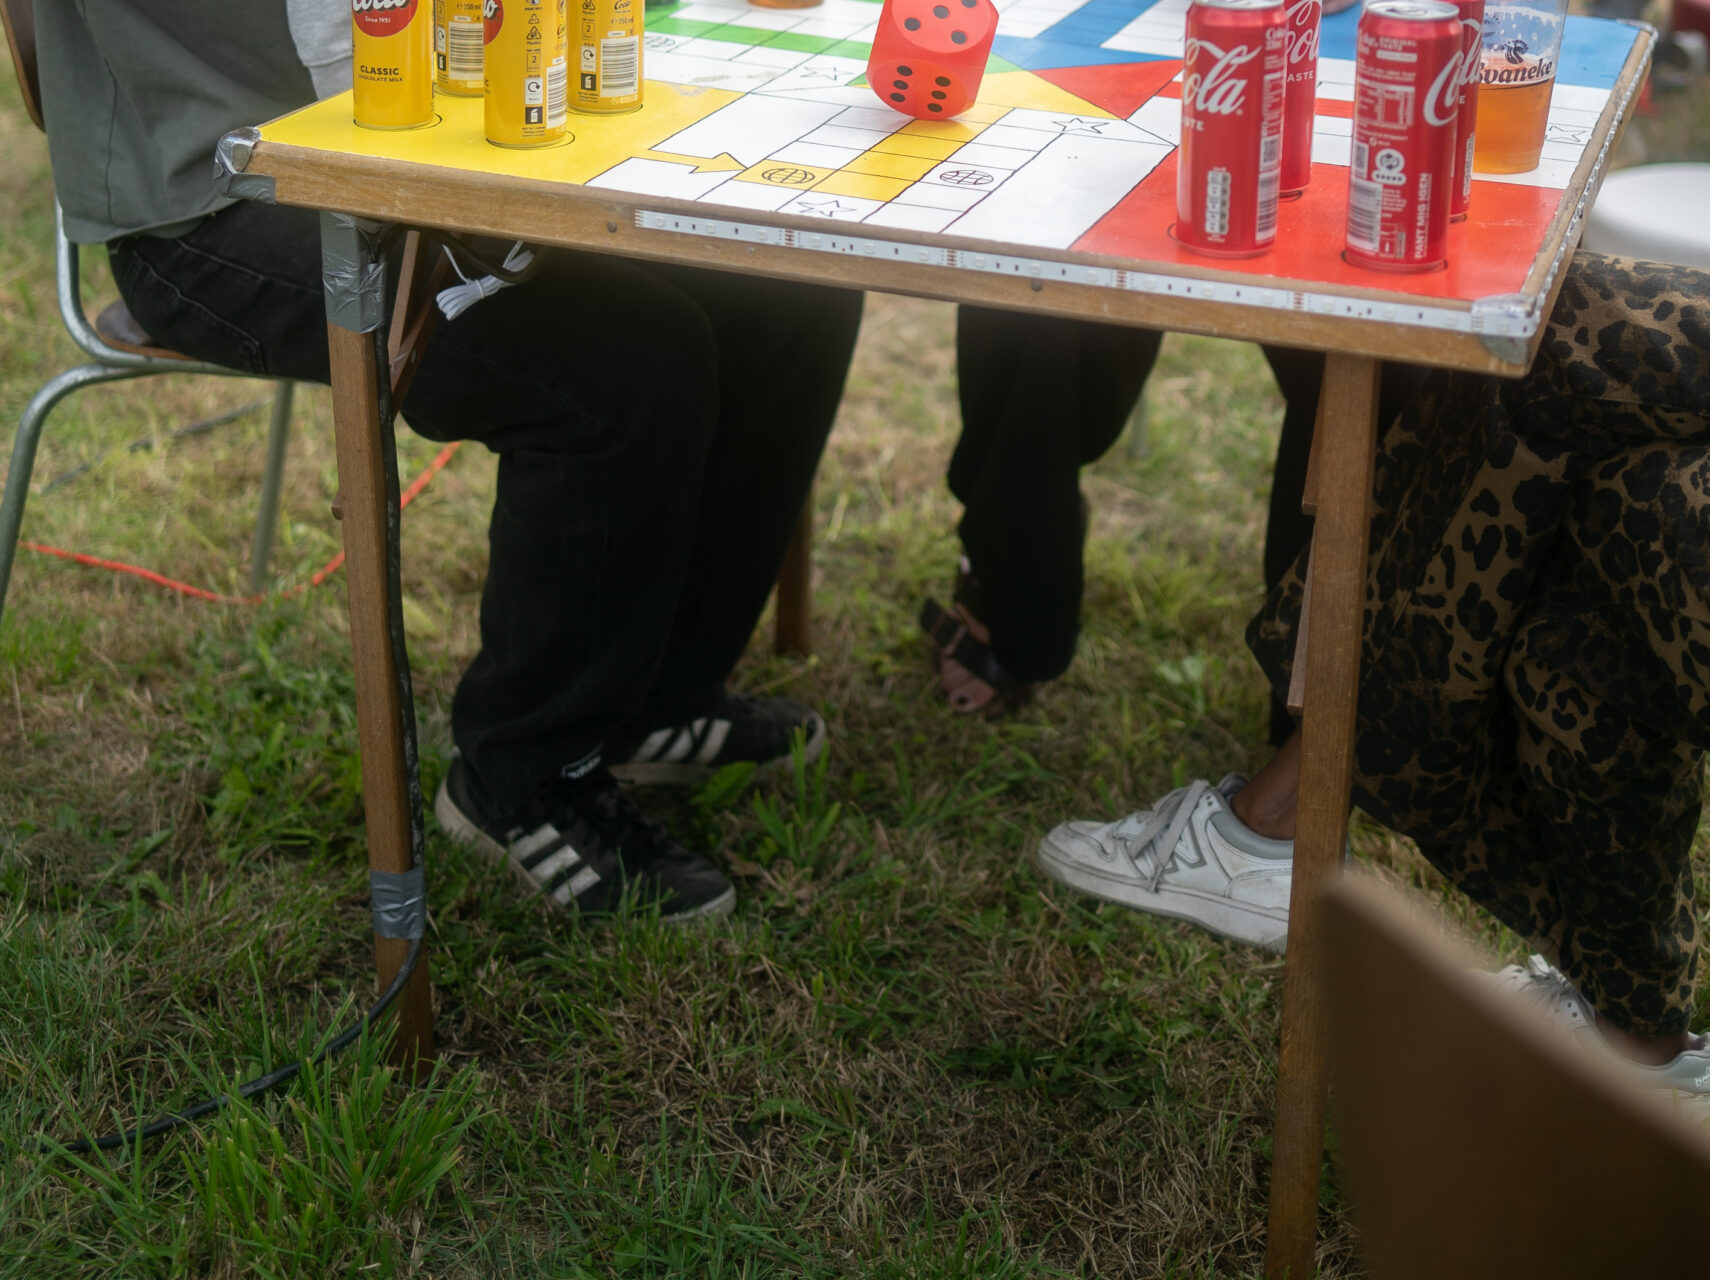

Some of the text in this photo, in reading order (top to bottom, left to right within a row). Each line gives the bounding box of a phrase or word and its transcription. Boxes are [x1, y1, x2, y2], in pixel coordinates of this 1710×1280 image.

[532, 55, 537, 64] 2
[360, 65, 400, 76] CLASSIC
[1287, 70, 1314, 82] ASTE
[359, 74, 387, 82] CHOCOLATE
[1414, 173, 1429, 259] PANT MIG IGEN
